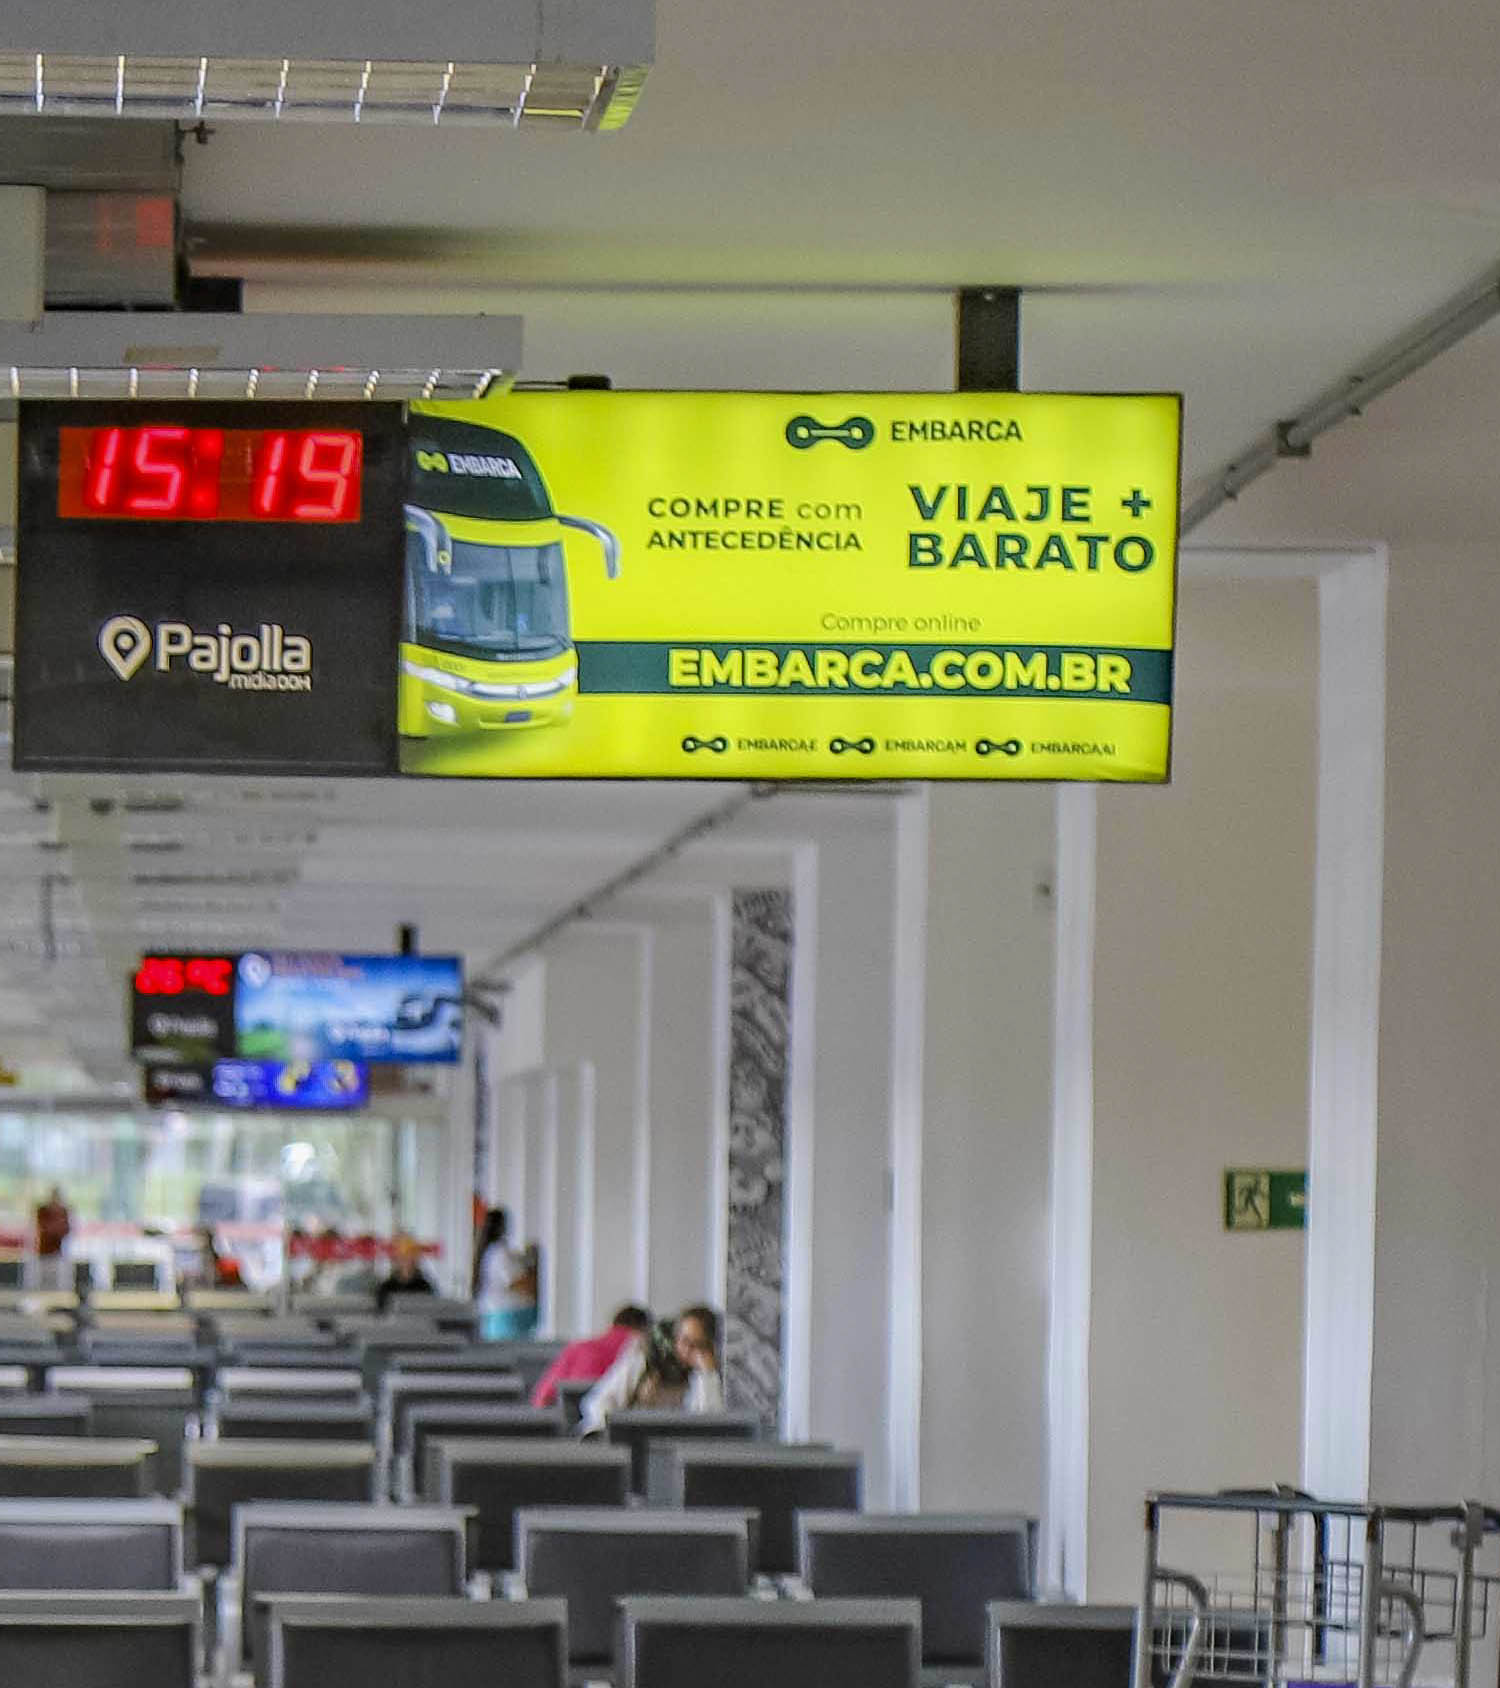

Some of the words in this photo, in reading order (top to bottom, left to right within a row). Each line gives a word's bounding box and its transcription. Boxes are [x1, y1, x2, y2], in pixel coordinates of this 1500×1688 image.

[891, 420, 1023, 442] EMBARCA
[95, 427, 356, 518] 15:19
[447, 453, 523, 480] EMBARCA
[647, 497, 784, 519] COMPRE
[797, 500, 863, 521] com
[908, 485, 1091, 523] VIAJE
[647, 525, 863, 551] ANTECEDÊNCIA
[908, 533, 1155, 573] BARATO
[821, 613, 908, 635] Compre
[914, 614, 983, 633] online
[155, 622, 312, 684] Pajolla
[668, 647, 1132, 694] EMBARCA.COM.BR
